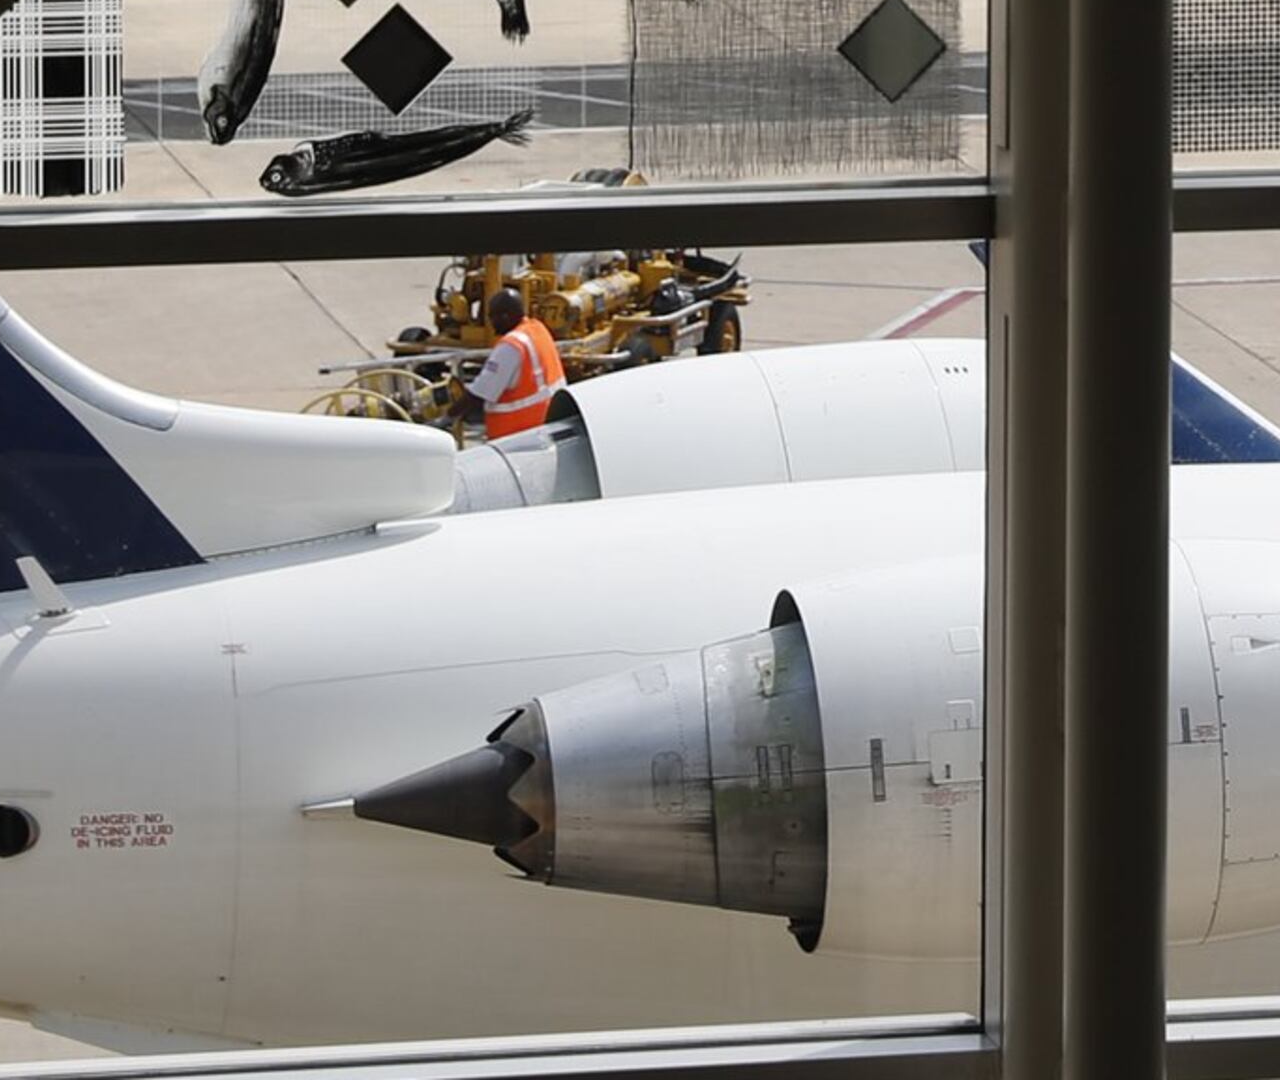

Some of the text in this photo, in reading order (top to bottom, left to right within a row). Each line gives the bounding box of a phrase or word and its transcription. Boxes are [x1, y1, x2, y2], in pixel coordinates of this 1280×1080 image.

[144, 813, 164, 823] NO
[71, 824, 174, 837] DE-ICING FLUID
[76, 836, 168, 848] IN THIS AREA
